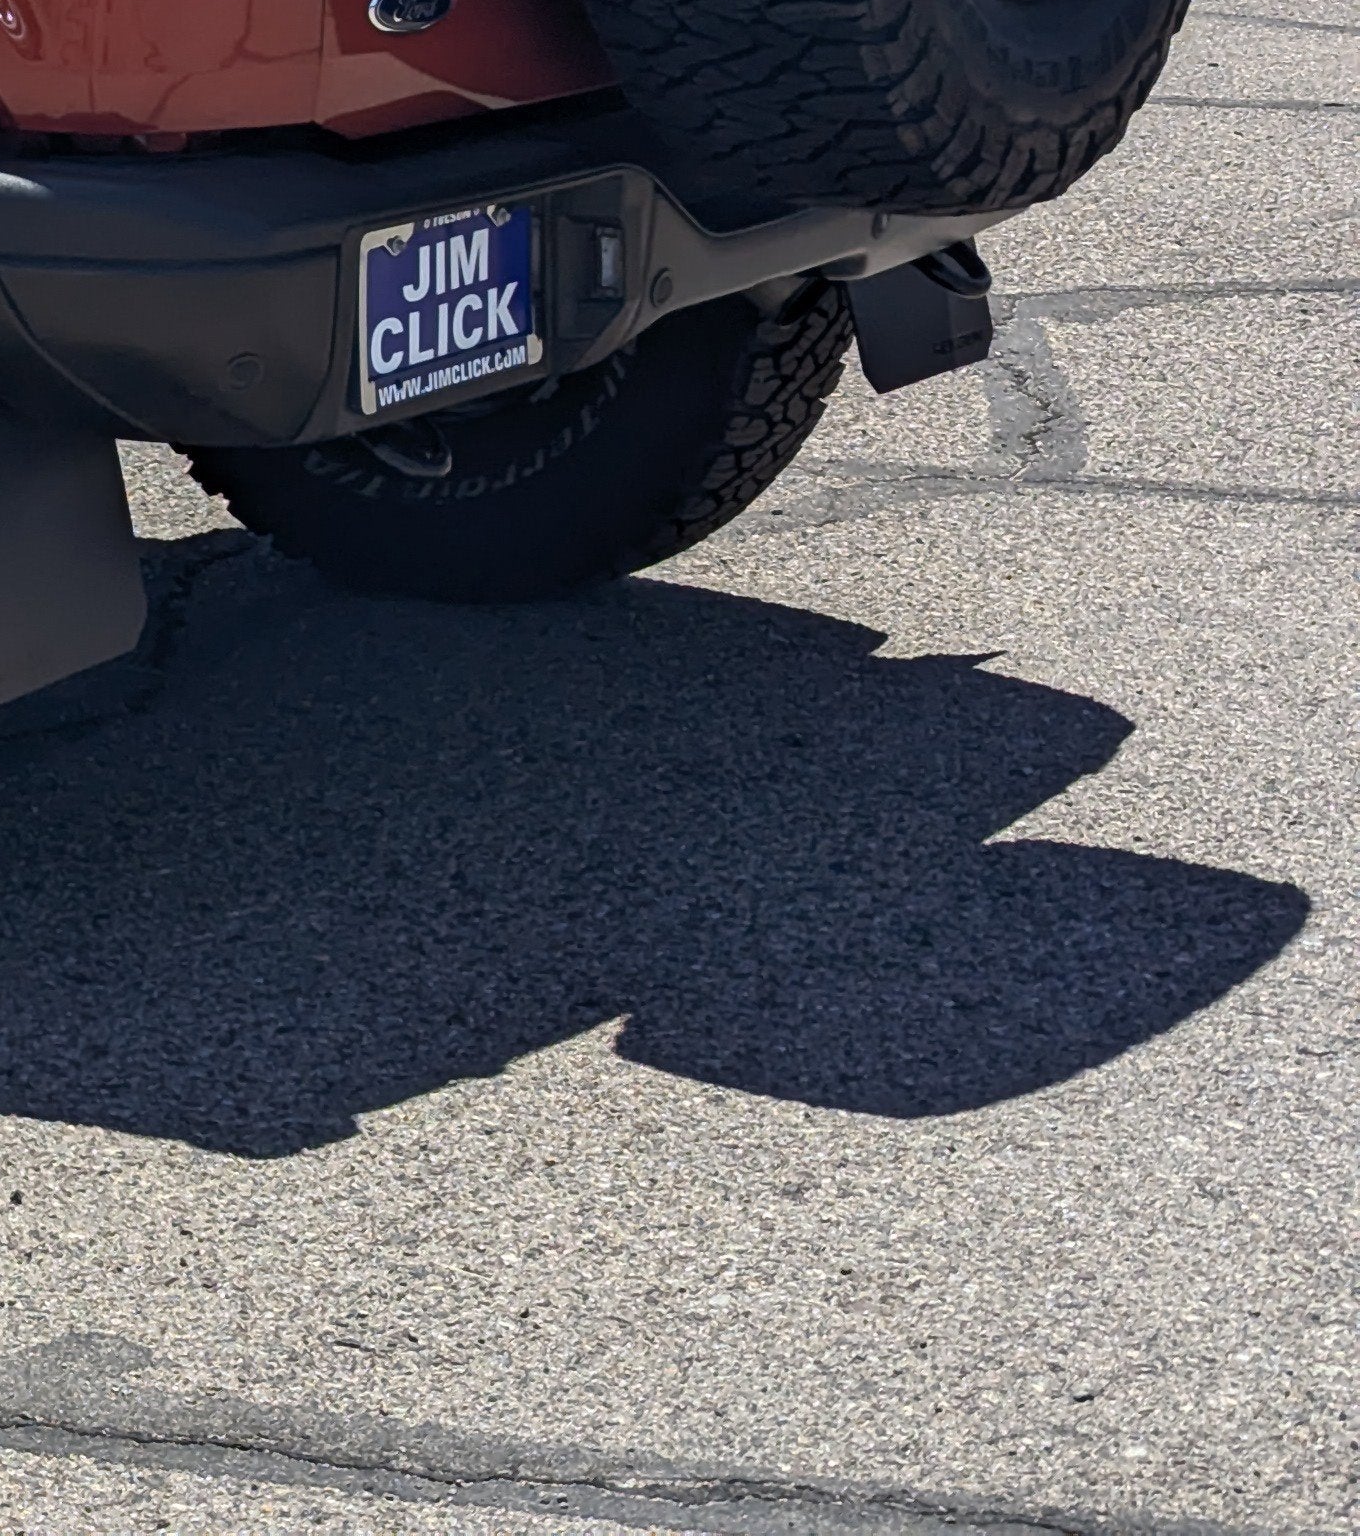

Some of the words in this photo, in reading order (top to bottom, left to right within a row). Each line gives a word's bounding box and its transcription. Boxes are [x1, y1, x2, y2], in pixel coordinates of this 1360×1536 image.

[401, 227, 490, 303] JIM
[370, 280, 520, 376] CLICK
[378, 344, 527, 408] WWW.JIMCLICK.COM
